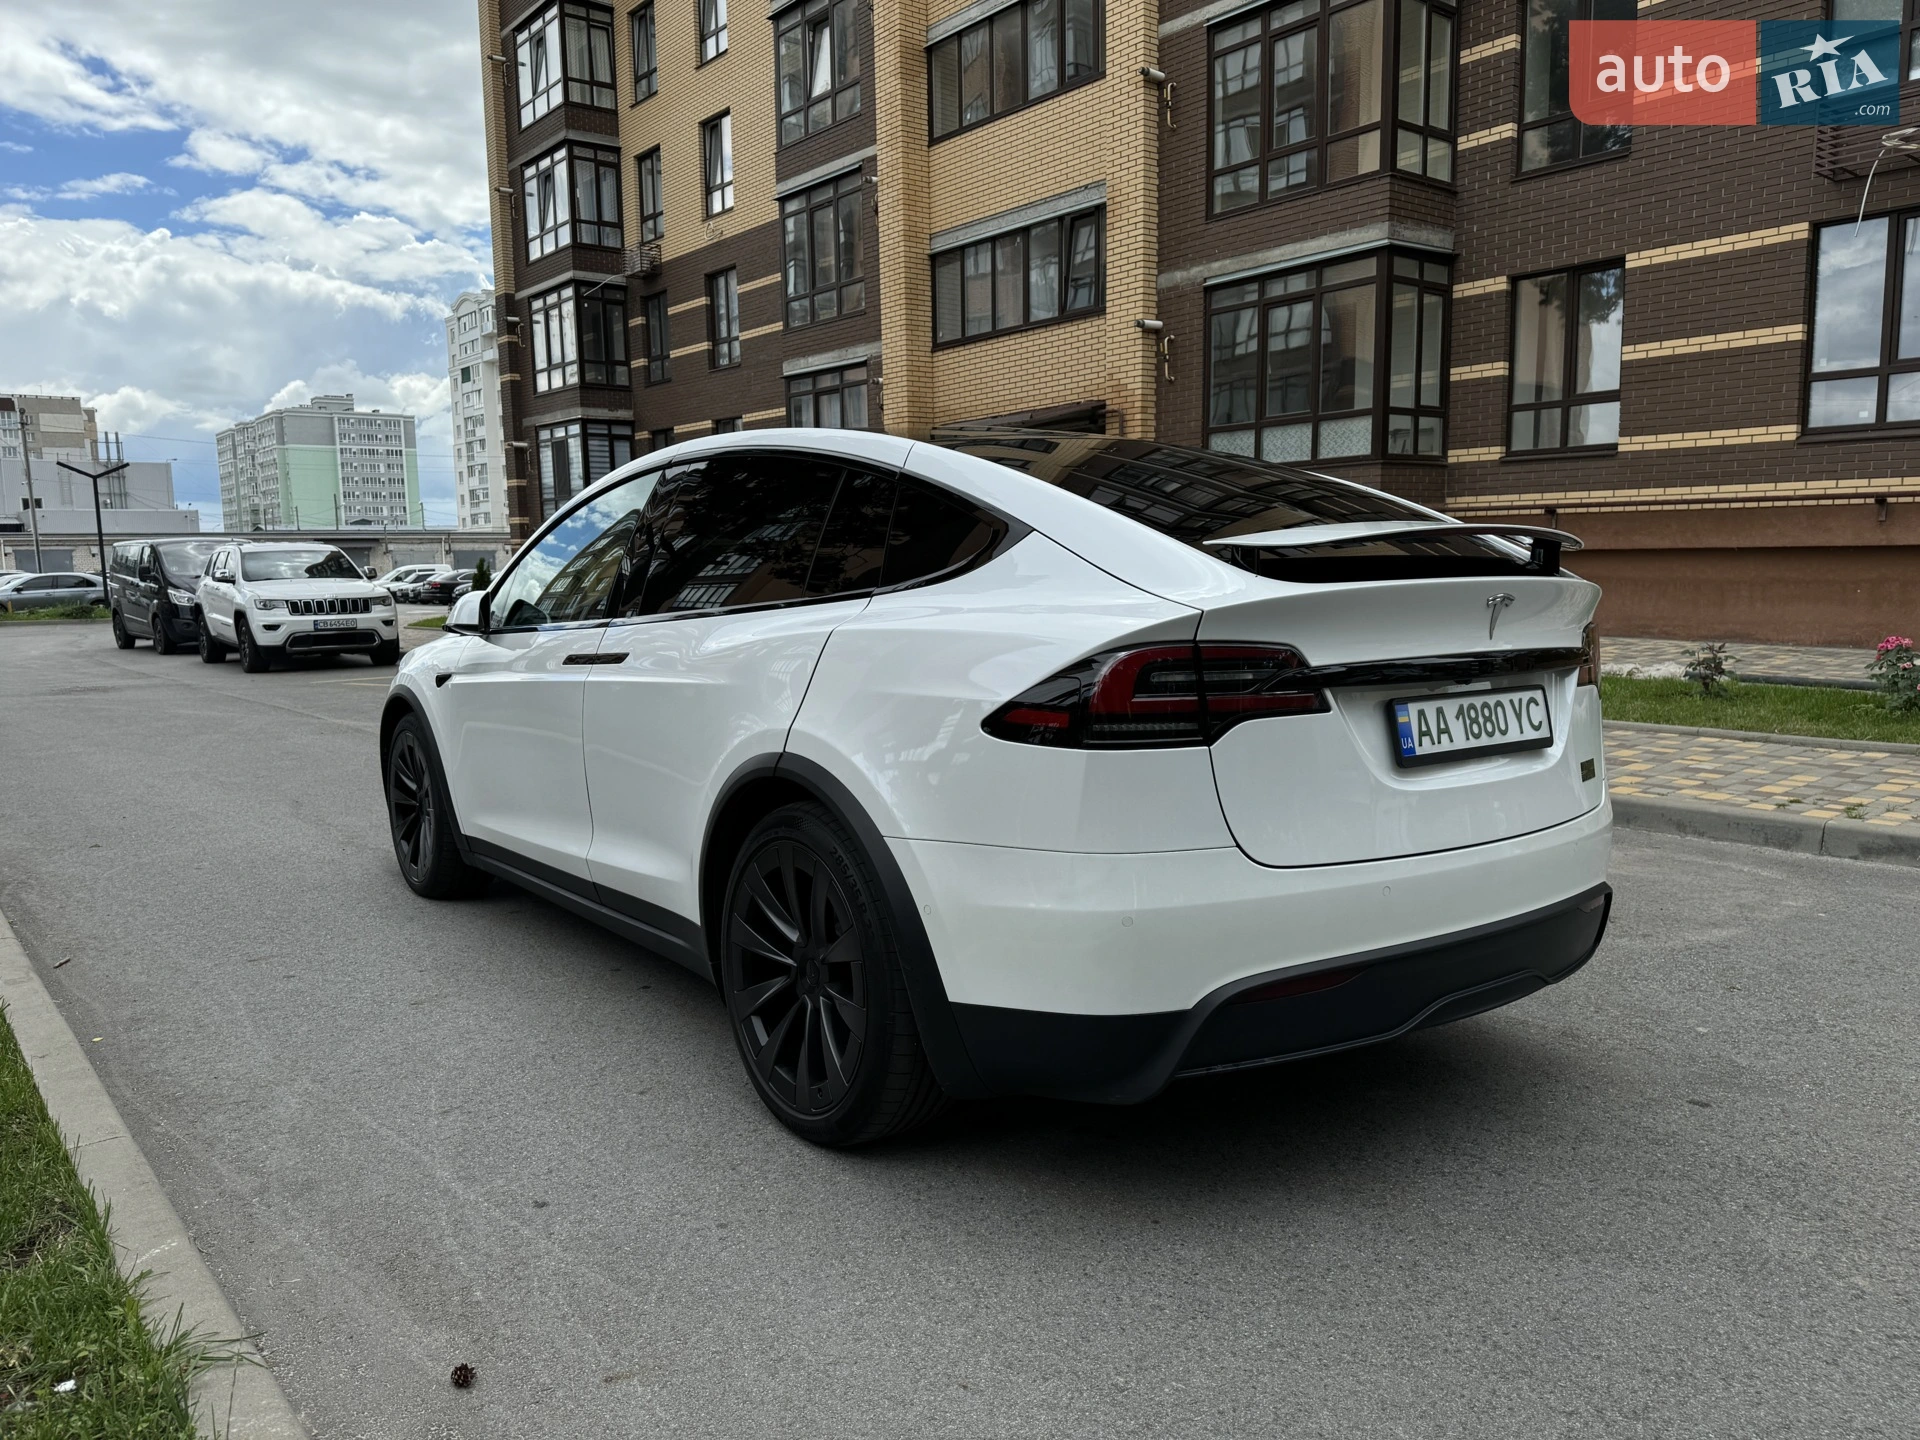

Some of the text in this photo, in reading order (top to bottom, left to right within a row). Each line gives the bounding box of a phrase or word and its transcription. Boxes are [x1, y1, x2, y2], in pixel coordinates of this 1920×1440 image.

[1417, 696, 1543, 747] AA 1880 YC
[1401, 736, 1414, 749] UA
